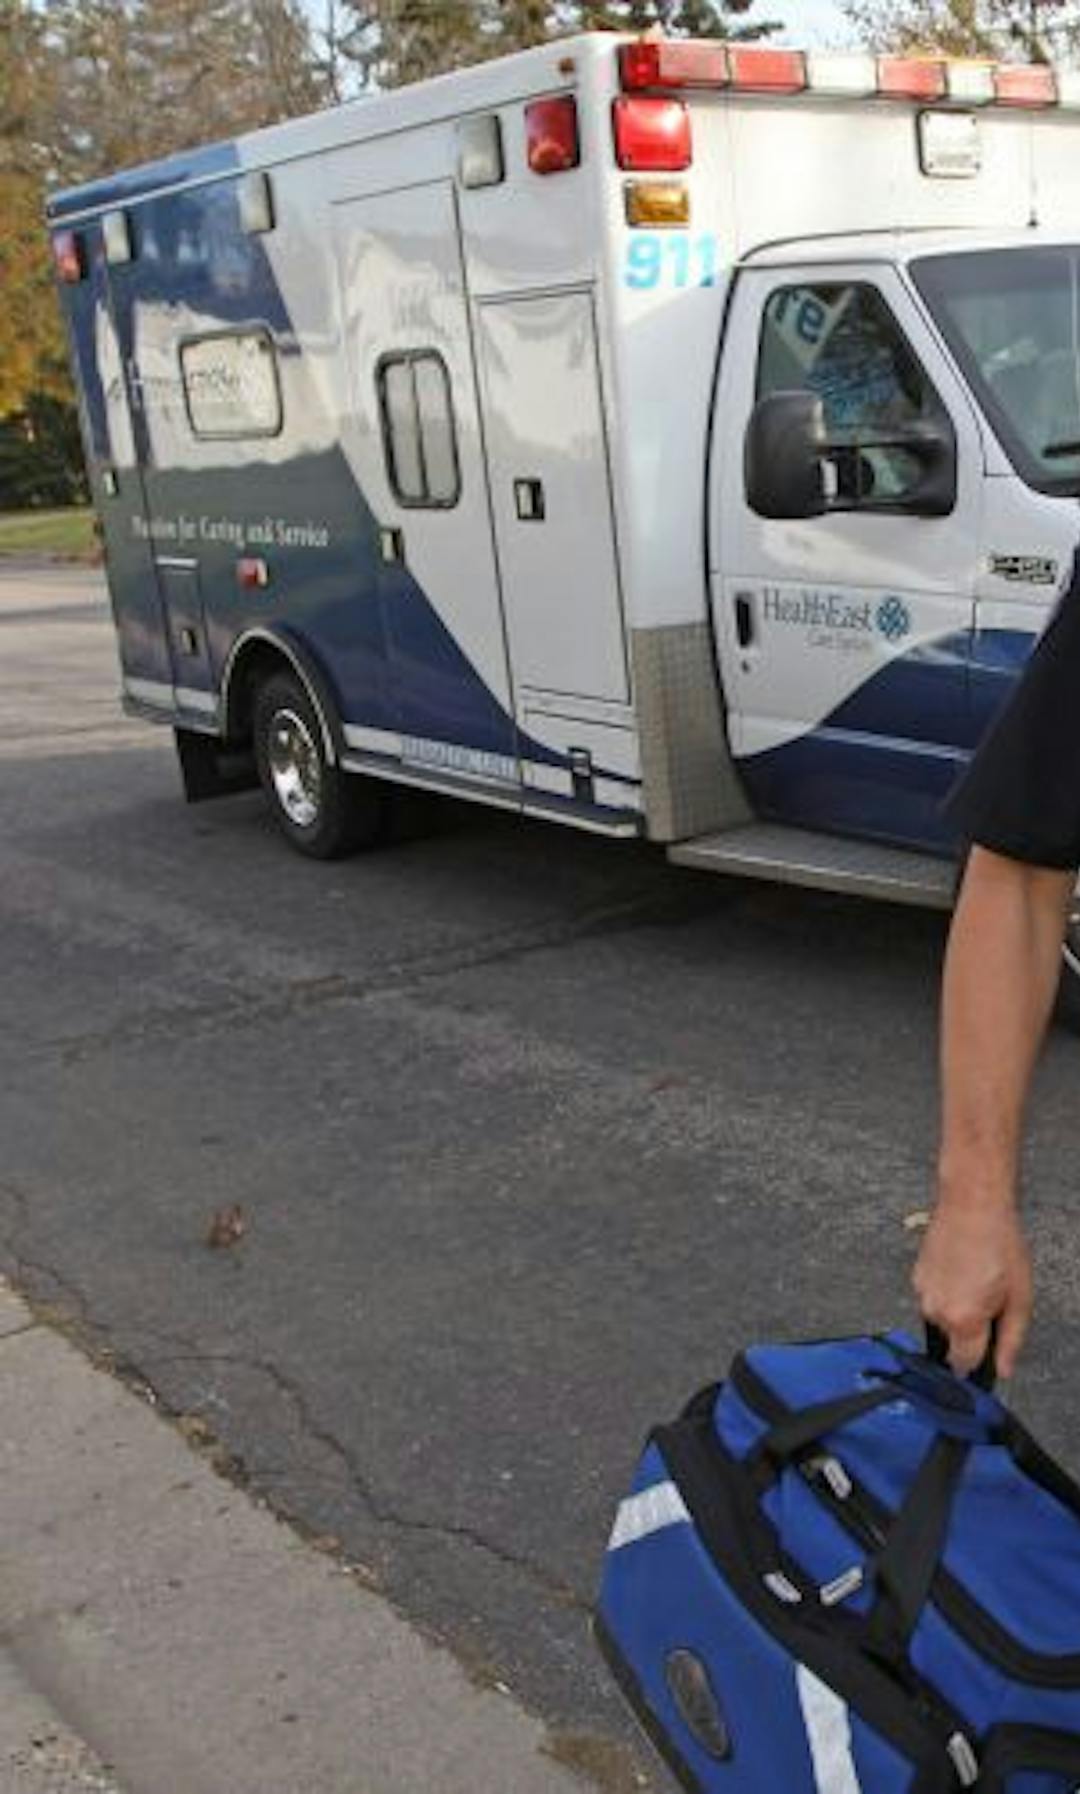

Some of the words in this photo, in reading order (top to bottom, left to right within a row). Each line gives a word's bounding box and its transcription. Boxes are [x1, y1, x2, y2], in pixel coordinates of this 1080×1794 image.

[626, 234, 715, 287] 911
[275, 518, 329, 547] Service
[763, 586, 873, 632] HealthEast
